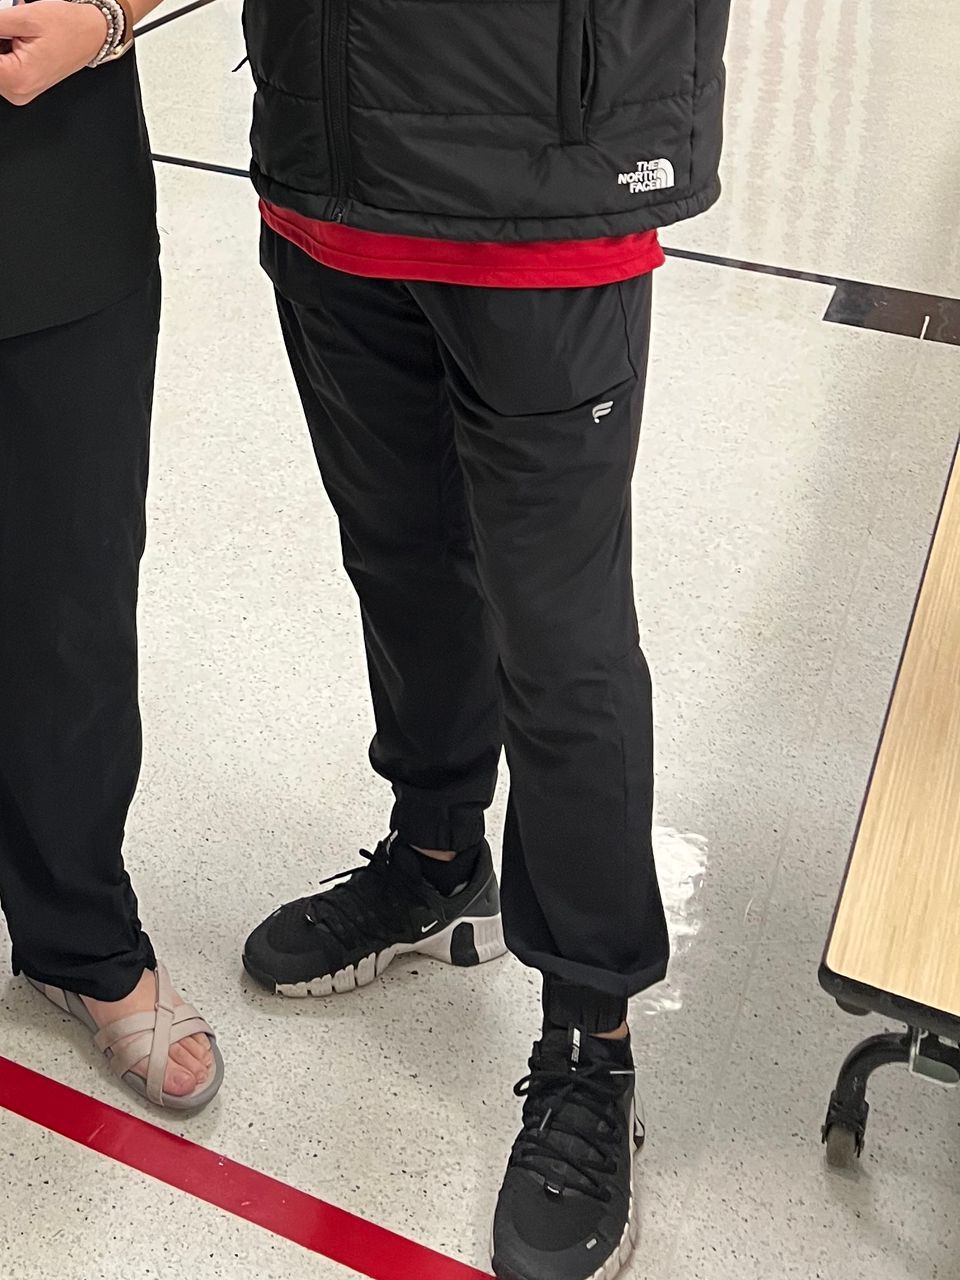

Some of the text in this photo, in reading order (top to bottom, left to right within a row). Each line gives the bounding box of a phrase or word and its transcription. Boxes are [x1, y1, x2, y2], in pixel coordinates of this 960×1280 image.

[636, 160, 659, 171] THE
[618, 170, 657, 185] NORTH
[630, 180, 657, 194] FACE
